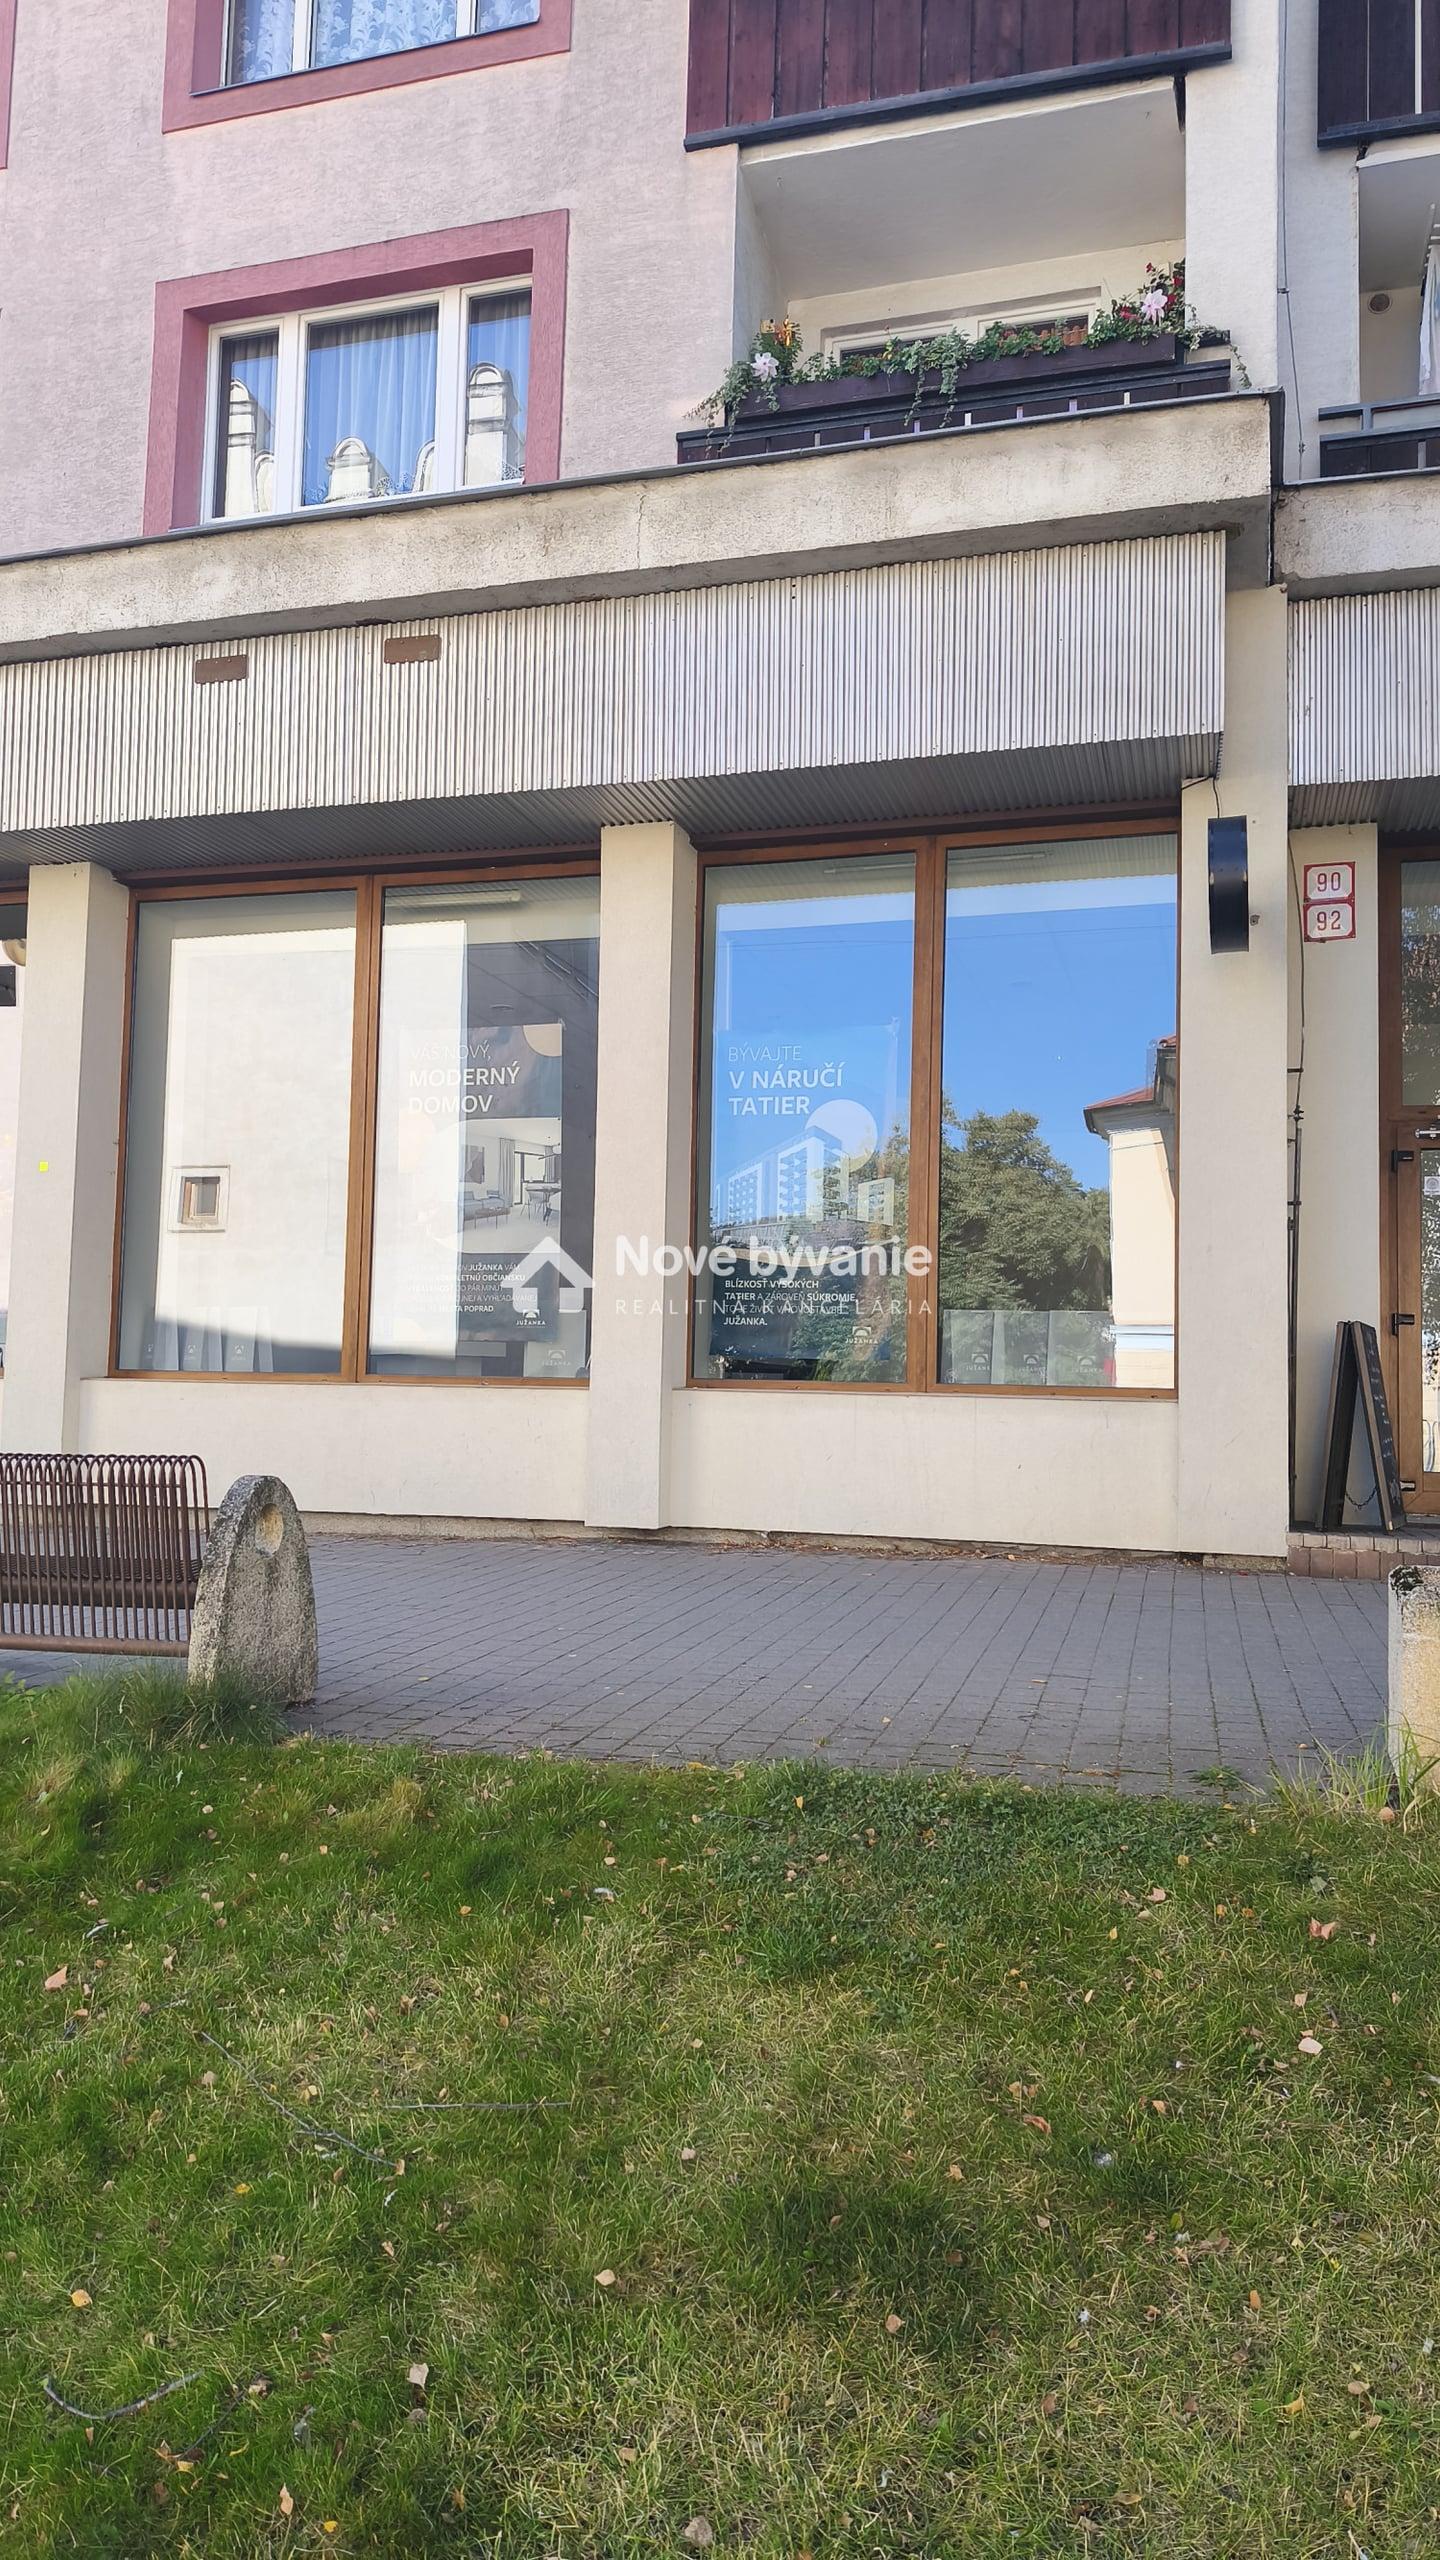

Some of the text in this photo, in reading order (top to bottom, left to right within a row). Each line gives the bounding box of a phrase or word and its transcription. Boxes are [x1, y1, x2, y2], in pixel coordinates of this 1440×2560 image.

[1317, 872, 1341, 892] 90
[1316, 910, 1341, 931] 92
[727, 1041, 802, 1062] BÝVAJTE
[408, 1060, 520, 1088] MODERNÝ
[728, 1061, 847, 1089] V NÁRUČÍ
[408, 1094, 493, 1114] DOMOV
[728, 1095, 811, 1116] TATIER
[725, 1277, 819, 1289] BLÍZKOSŤ VYSOKÝCH
[724, 1292, 757, 1301] TATIER
[723, 1315, 768, 1326] JUŽANKA.
